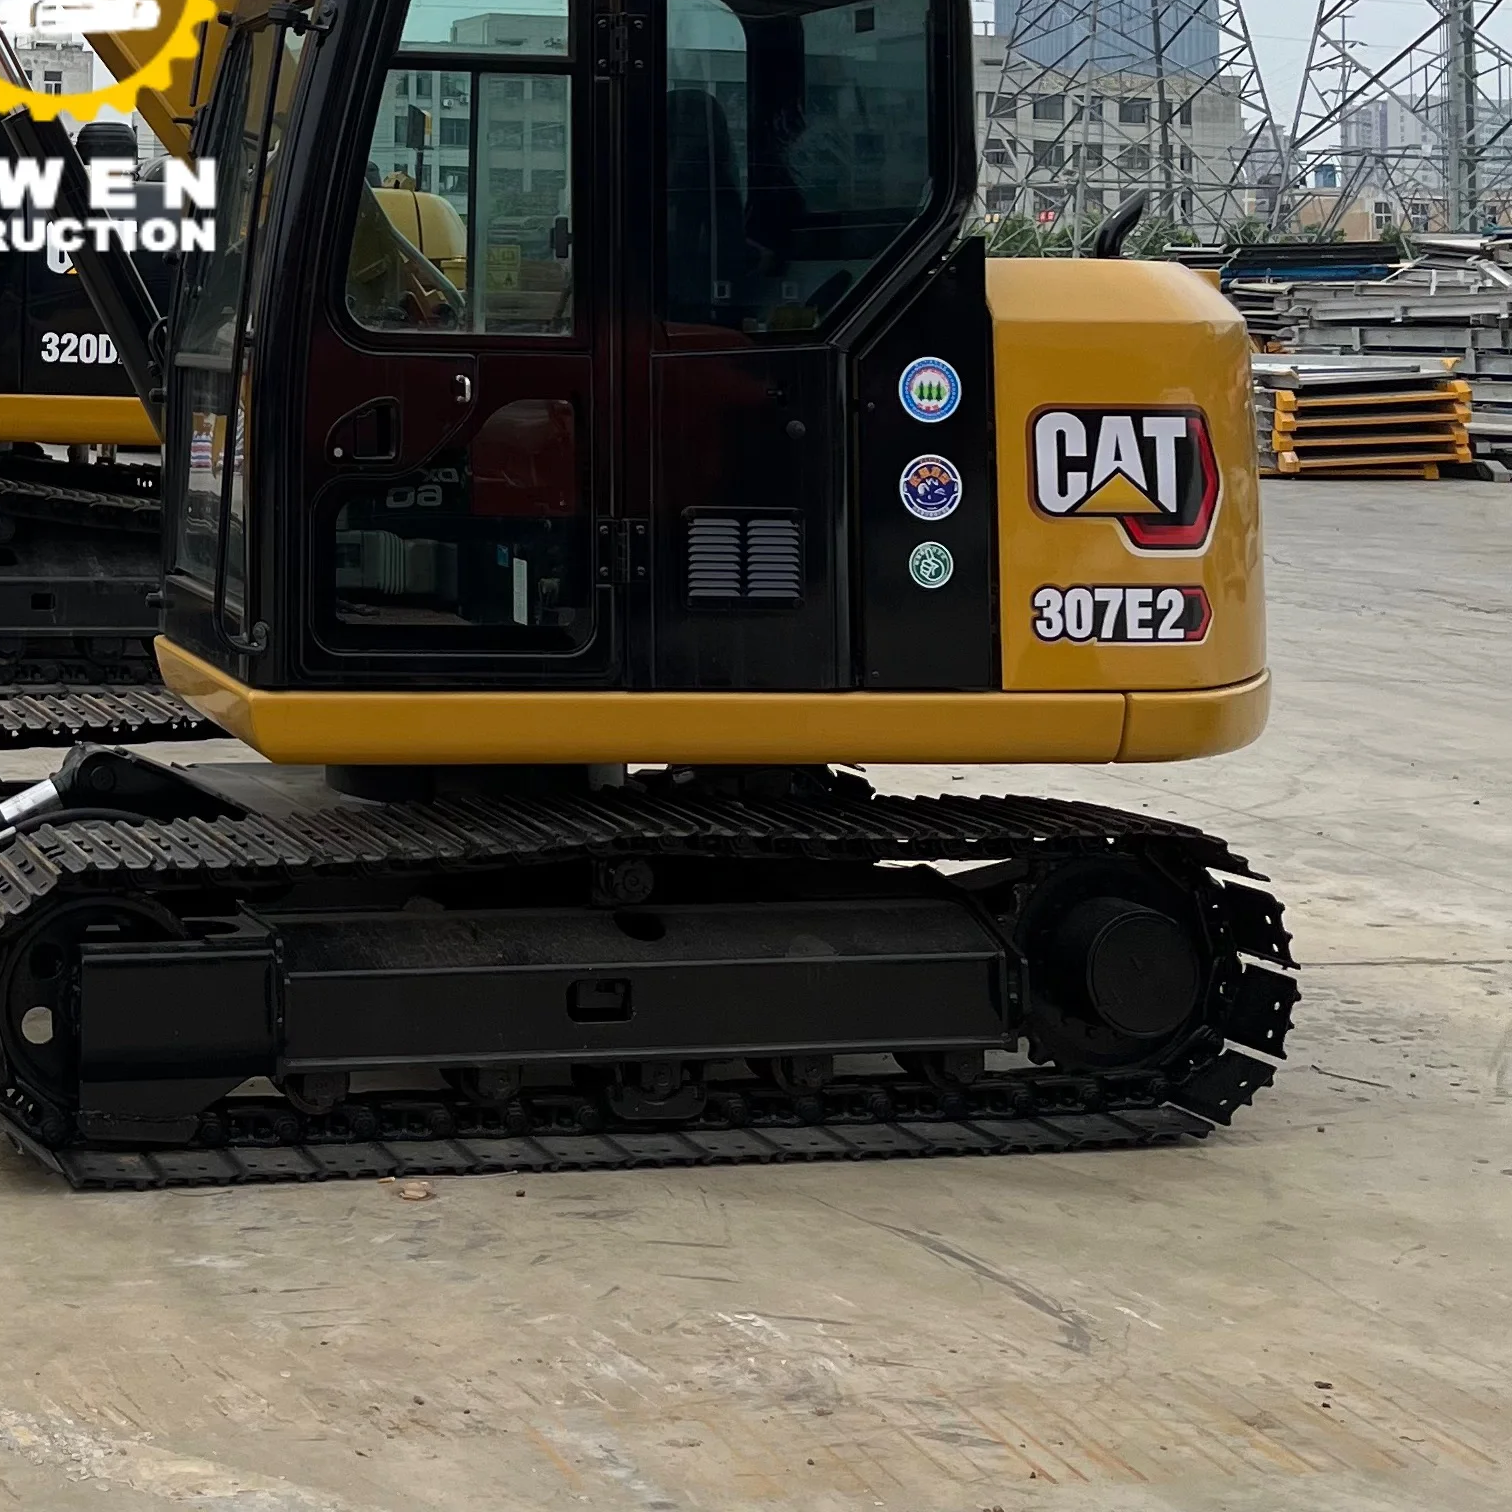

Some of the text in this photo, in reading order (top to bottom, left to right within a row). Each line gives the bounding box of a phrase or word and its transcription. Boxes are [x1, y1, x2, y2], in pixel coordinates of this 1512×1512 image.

[41, 332, 124, 365] 320D
[1034, 411, 1187, 514] CAT
[1034, 588, 1186, 640] 307E2
